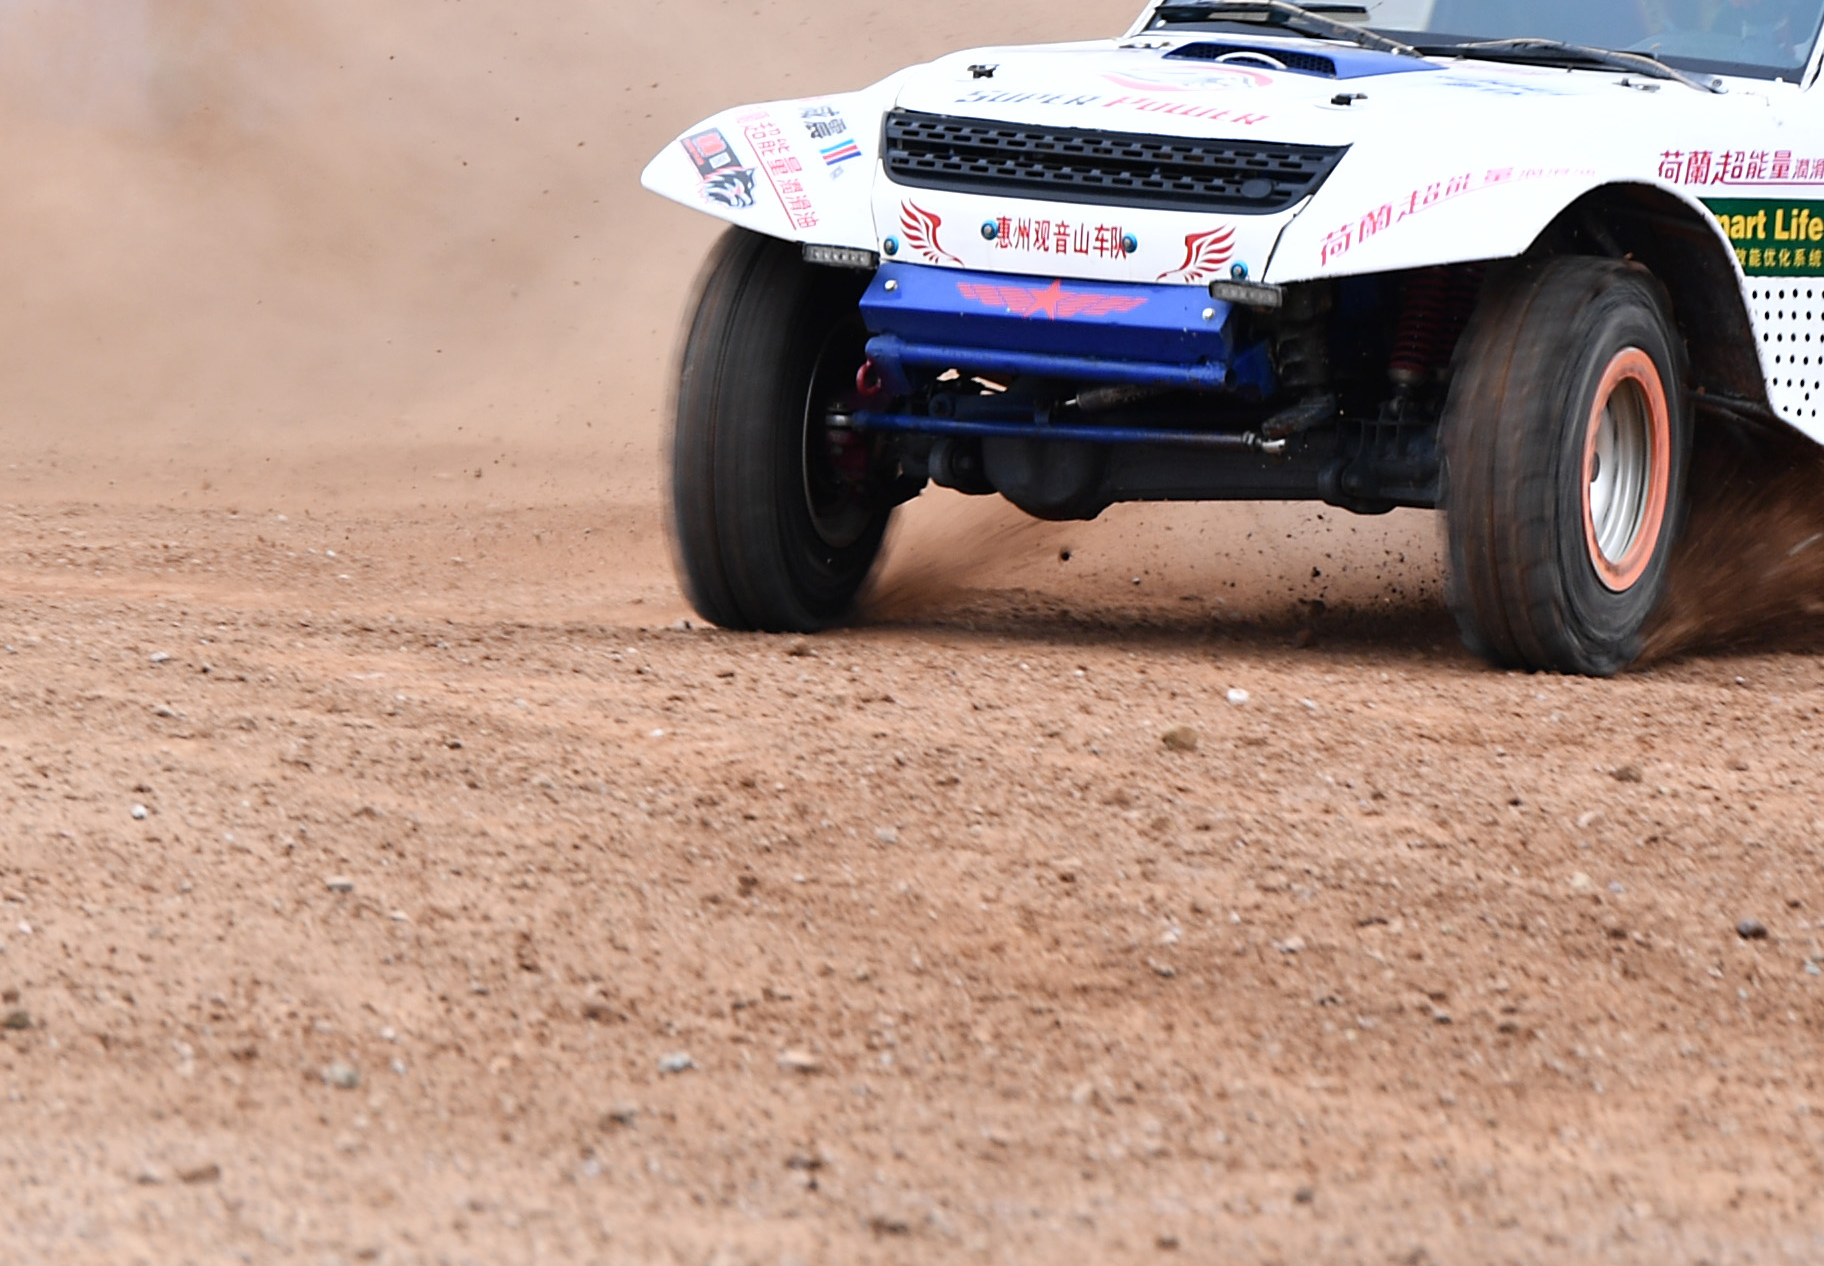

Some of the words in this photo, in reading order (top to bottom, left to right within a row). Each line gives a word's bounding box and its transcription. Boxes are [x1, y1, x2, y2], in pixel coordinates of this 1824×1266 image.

[954, 90, 1101, 107] SUPER
[1102, 96, 1271, 126] POWER
[995, 215, 1129, 261] 惠州观音山车队
[1774, 208, 1824, 242] Life
